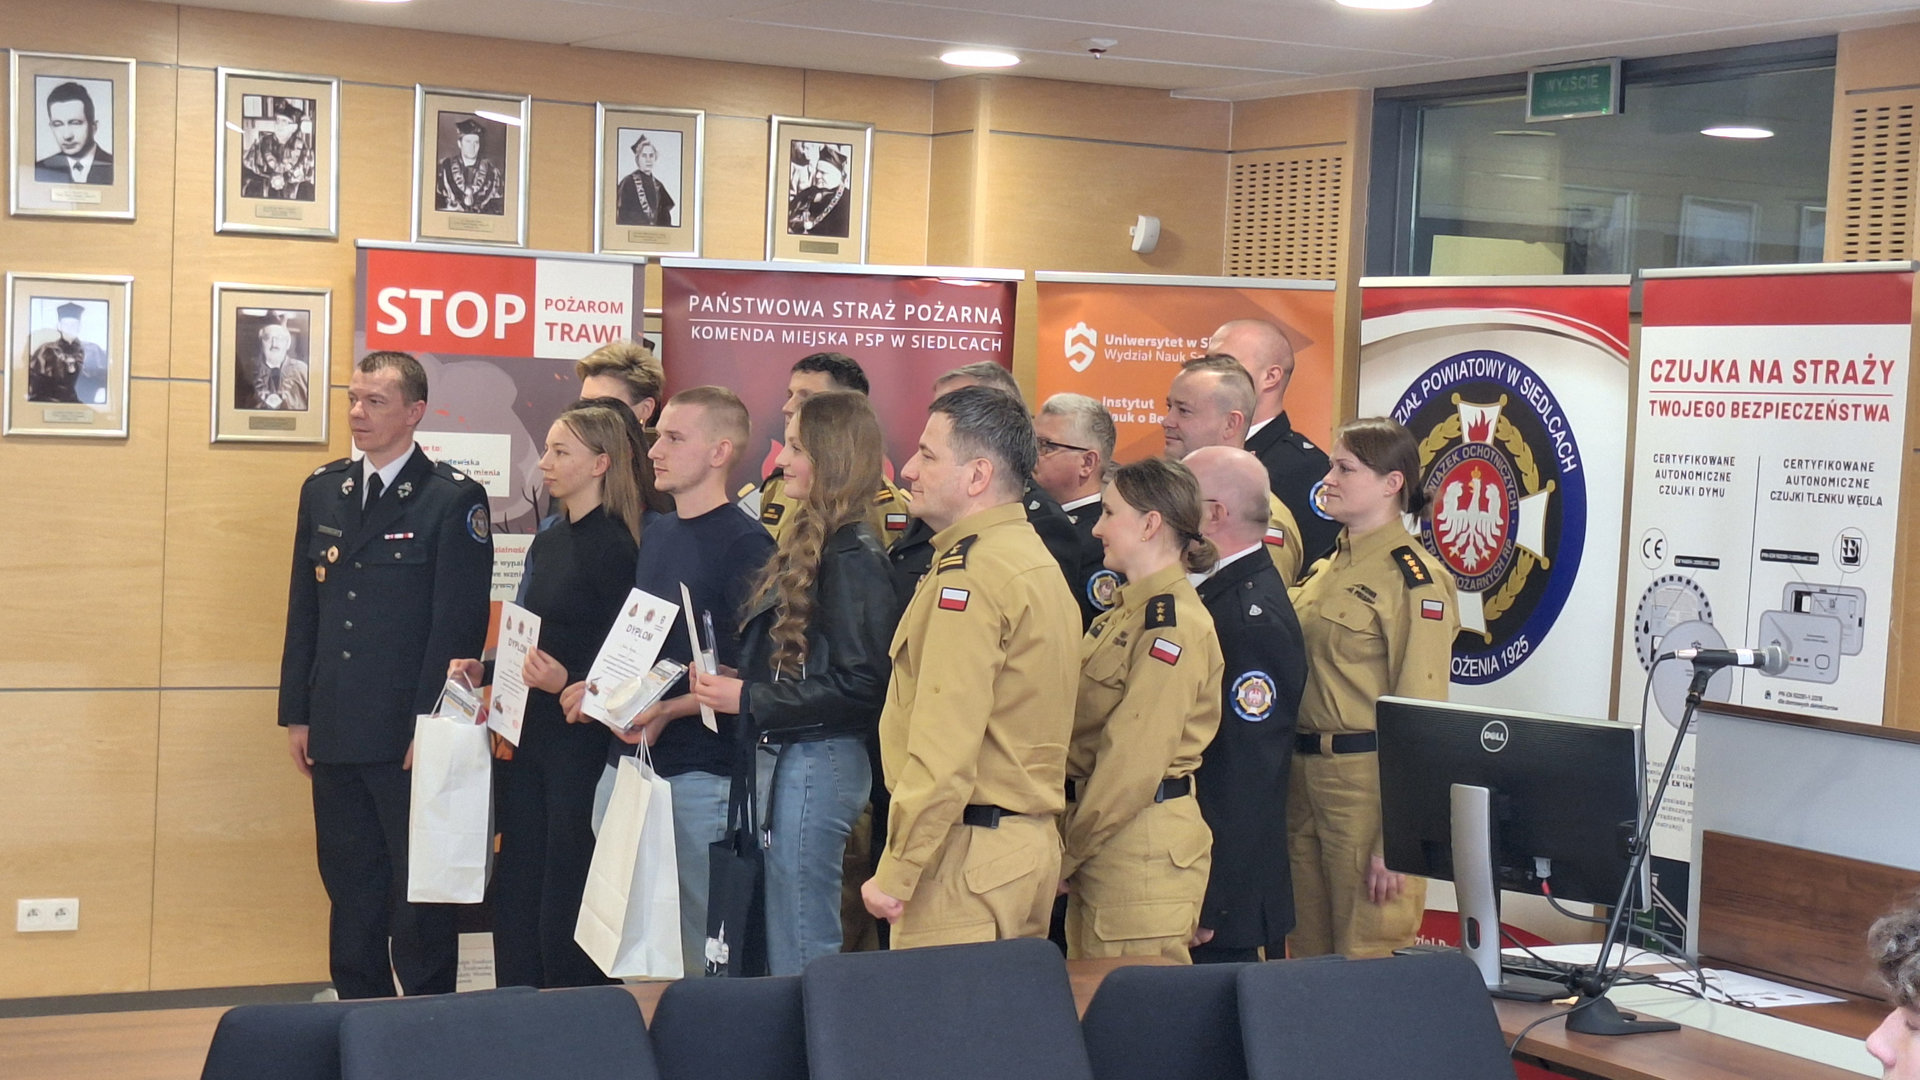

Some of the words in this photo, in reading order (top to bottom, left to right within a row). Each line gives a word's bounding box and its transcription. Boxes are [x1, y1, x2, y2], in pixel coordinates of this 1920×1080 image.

[376, 287, 527, 340] STOP
[544, 296, 624, 314] POŻAROM
[689, 291, 824, 318] PAŃSTWOWA
[832, 299, 896, 320] STRAŻ
[904, 302, 1003, 325] POŻARNA
[544, 321, 623, 344] TRAW!
[691, 325, 776, 344] KOMENDA
[781, 330, 849, 348] MIEJSKA
[854, 333, 885, 347] PSP
[890, 335, 906, 348] W
[911, 335, 1003, 352] SIEDLCACH
[1104, 334, 1184, 349] Uniwersytet
[1186, 339, 1198, 348] w
[1104, 348, 1152, 362] Wydział
[1155, 353, 1186, 363] Nauk
[1650, 359, 1740, 383] CZUJKA
[1749, 360, 1783, 384] NA
[1792, 353, 1895, 385] STRAŻY
[1102, 396, 1154, 411] Instytut
[1649, 399, 1725, 418] TWOJEGO
[1730, 399, 1890, 422] BEZPIECZEŃSTWA
[1111, 412, 1135, 423] auk
[1138, 414, 1146, 423] o
[1149, 413, 1166, 424] Be
[1394, 391, 1423, 426] ZIAŁ
[1421, 358, 1506, 398] POWIATOWY
[1507, 364, 1522, 387] W
[1520, 376, 1577, 473] SIEDLCACH
[1653, 453, 1736, 467] CERTYFIKOWANE
[1783, 458, 1875, 472] CERTYFIKOWANE
[1462, 445, 1518, 511] OCHOTNICZYCH
[1655, 469, 1731, 483] AUTONOMICZNE
[1785, 475, 1870, 489] AUTONOMICZNE
[1658, 485, 1695, 496] CZUJKI
[1698, 487, 1725, 498] DYMU
[1769, 490, 1804, 502] CZUJKI
[1806, 492, 1844, 504] TLENKU
[1847, 495, 1883, 507] WĘGLA
[626, 624, 654, 642] DYPLOM
[1451, 655, 1500, 677] OŻENIA
[1500, 634, 1529, 668] 1925
[1484, 730, 1505, 741] DELL
